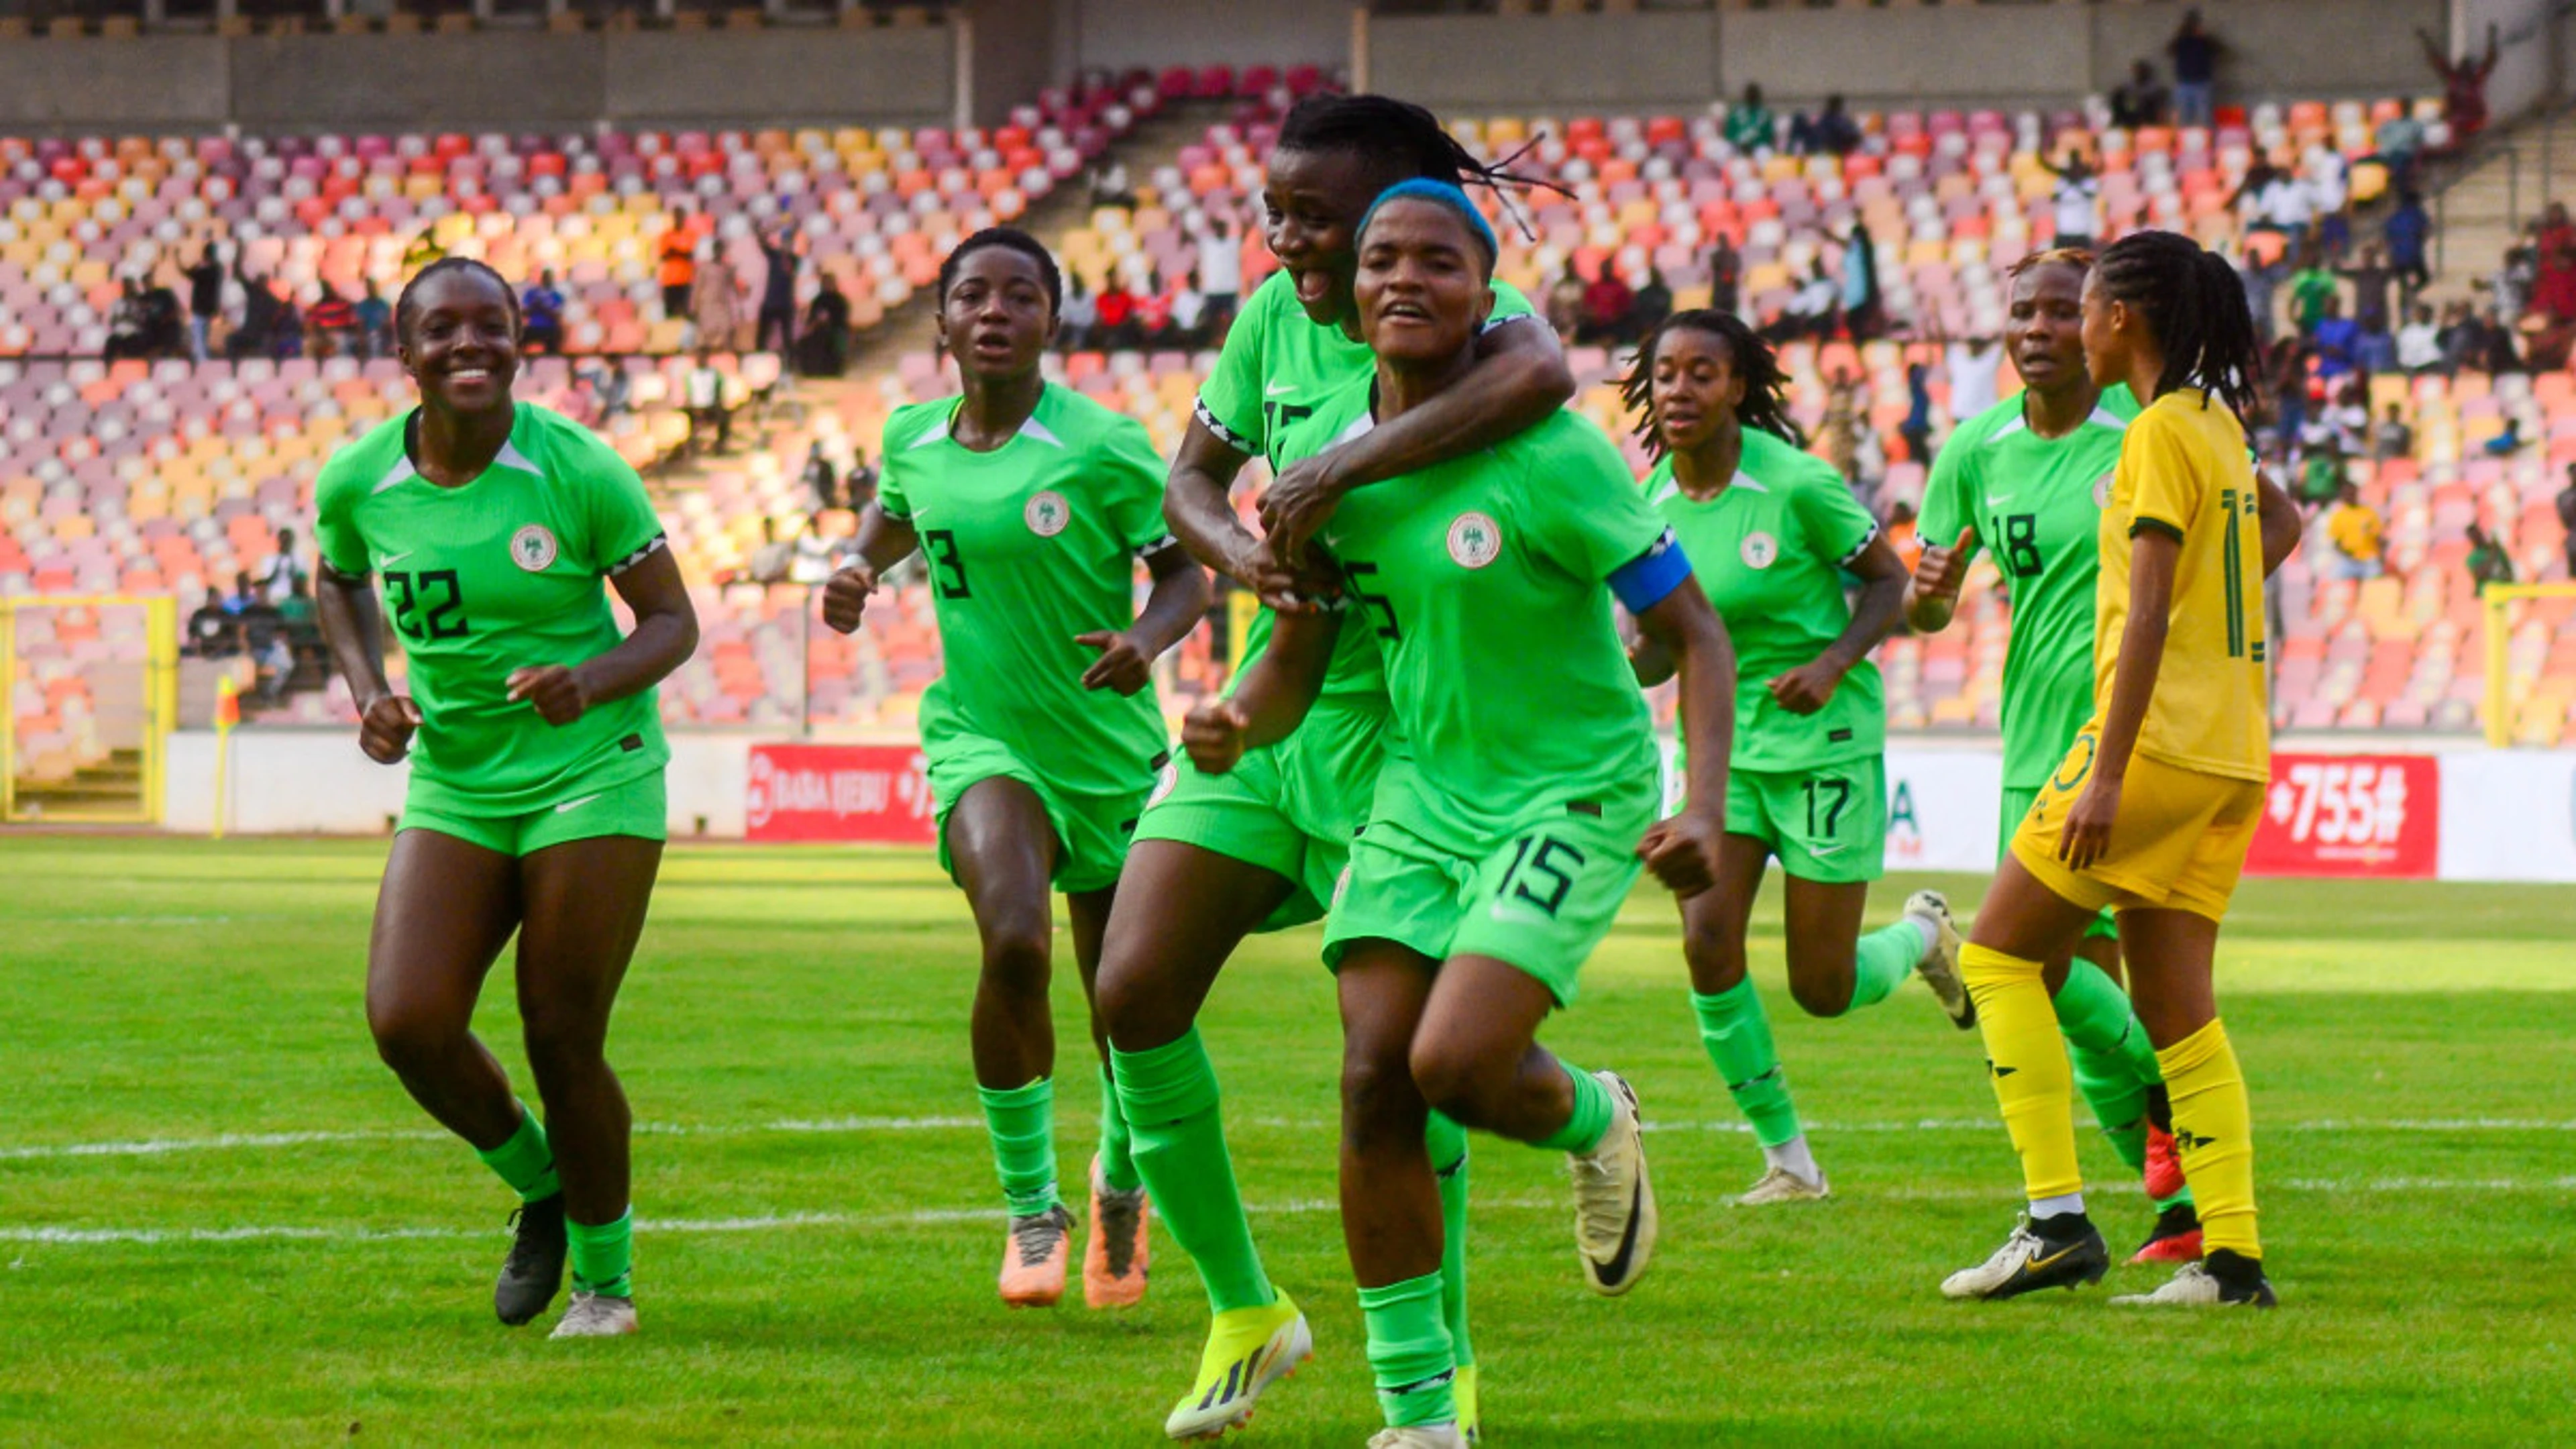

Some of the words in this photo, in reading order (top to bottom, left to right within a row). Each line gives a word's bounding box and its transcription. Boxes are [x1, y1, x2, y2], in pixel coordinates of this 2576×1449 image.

[1992, 515, 2044, 578] 18
[384, 570, 468, 639] 22
[1802, 779, 1849, 838] 17
[1498, 835, 1585, 919] 15
